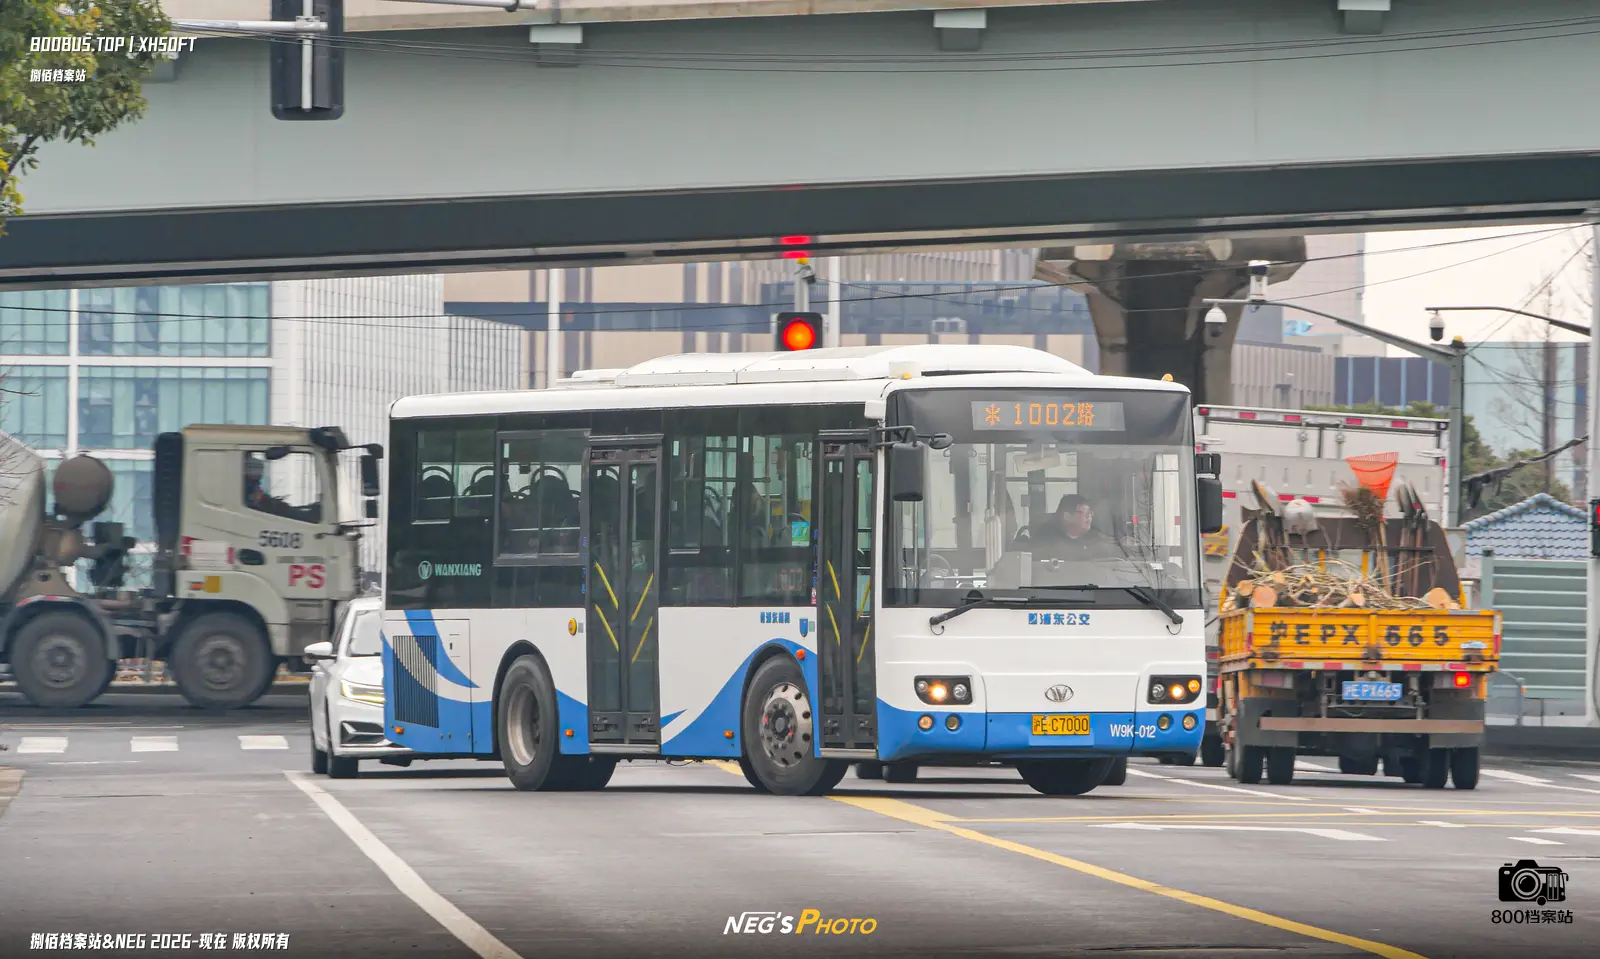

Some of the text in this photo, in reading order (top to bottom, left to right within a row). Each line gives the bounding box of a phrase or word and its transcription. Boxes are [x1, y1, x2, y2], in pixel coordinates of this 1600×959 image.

[1014, 402, 1095, 427] 1002路
[288, 564, 326, 589] PS
[434, 563, 482, 577] WANXIANG
[1109, 723, 1157, 739] W9K-012
